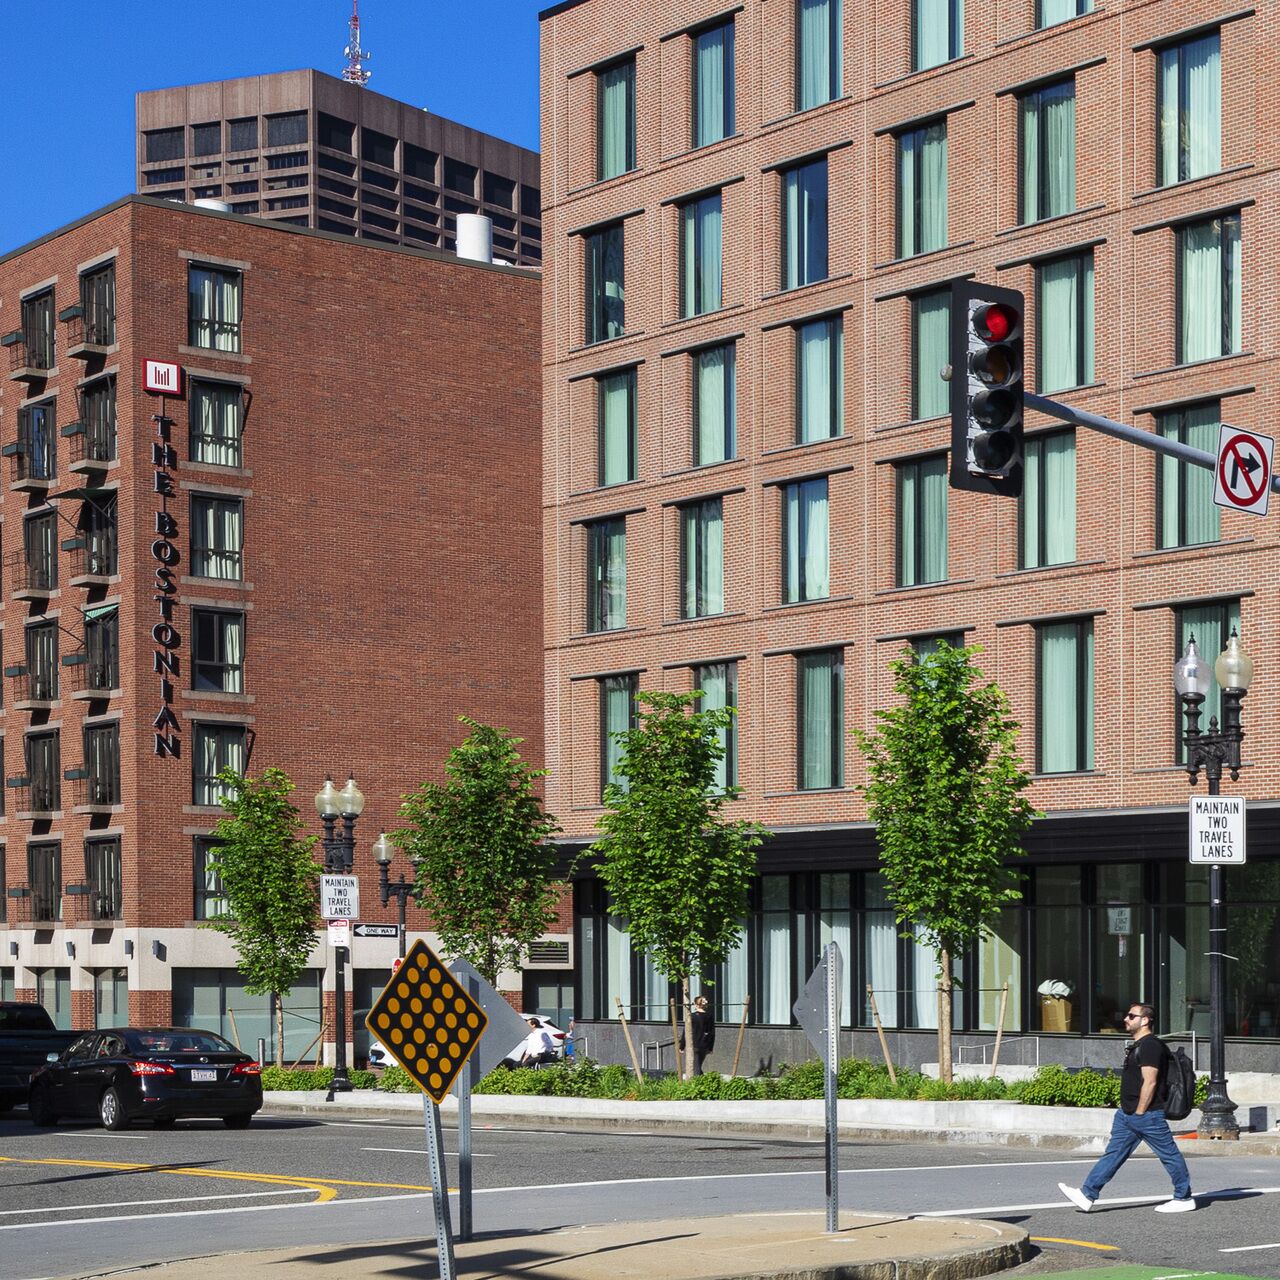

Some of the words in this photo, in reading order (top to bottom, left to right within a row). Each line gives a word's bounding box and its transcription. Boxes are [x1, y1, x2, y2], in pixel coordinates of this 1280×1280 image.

[151, 414, 174, 493] THE
[151, 511, 175, 755] BOSTONIAN
[1195, 802, 1239, 814] MAINTAIN
[1208, 816, 1228, 829] TWO
[1199, 831, 1234, 843] TRAVEL
[1202, 845, 1233, 858] LANES
[325, 878, 355, 887] MAINTAIN
[334, 888, 348, 897] TWO
[328, 897, 352, 906] TRAVEL
[329, 907, 352, 916] LANES
